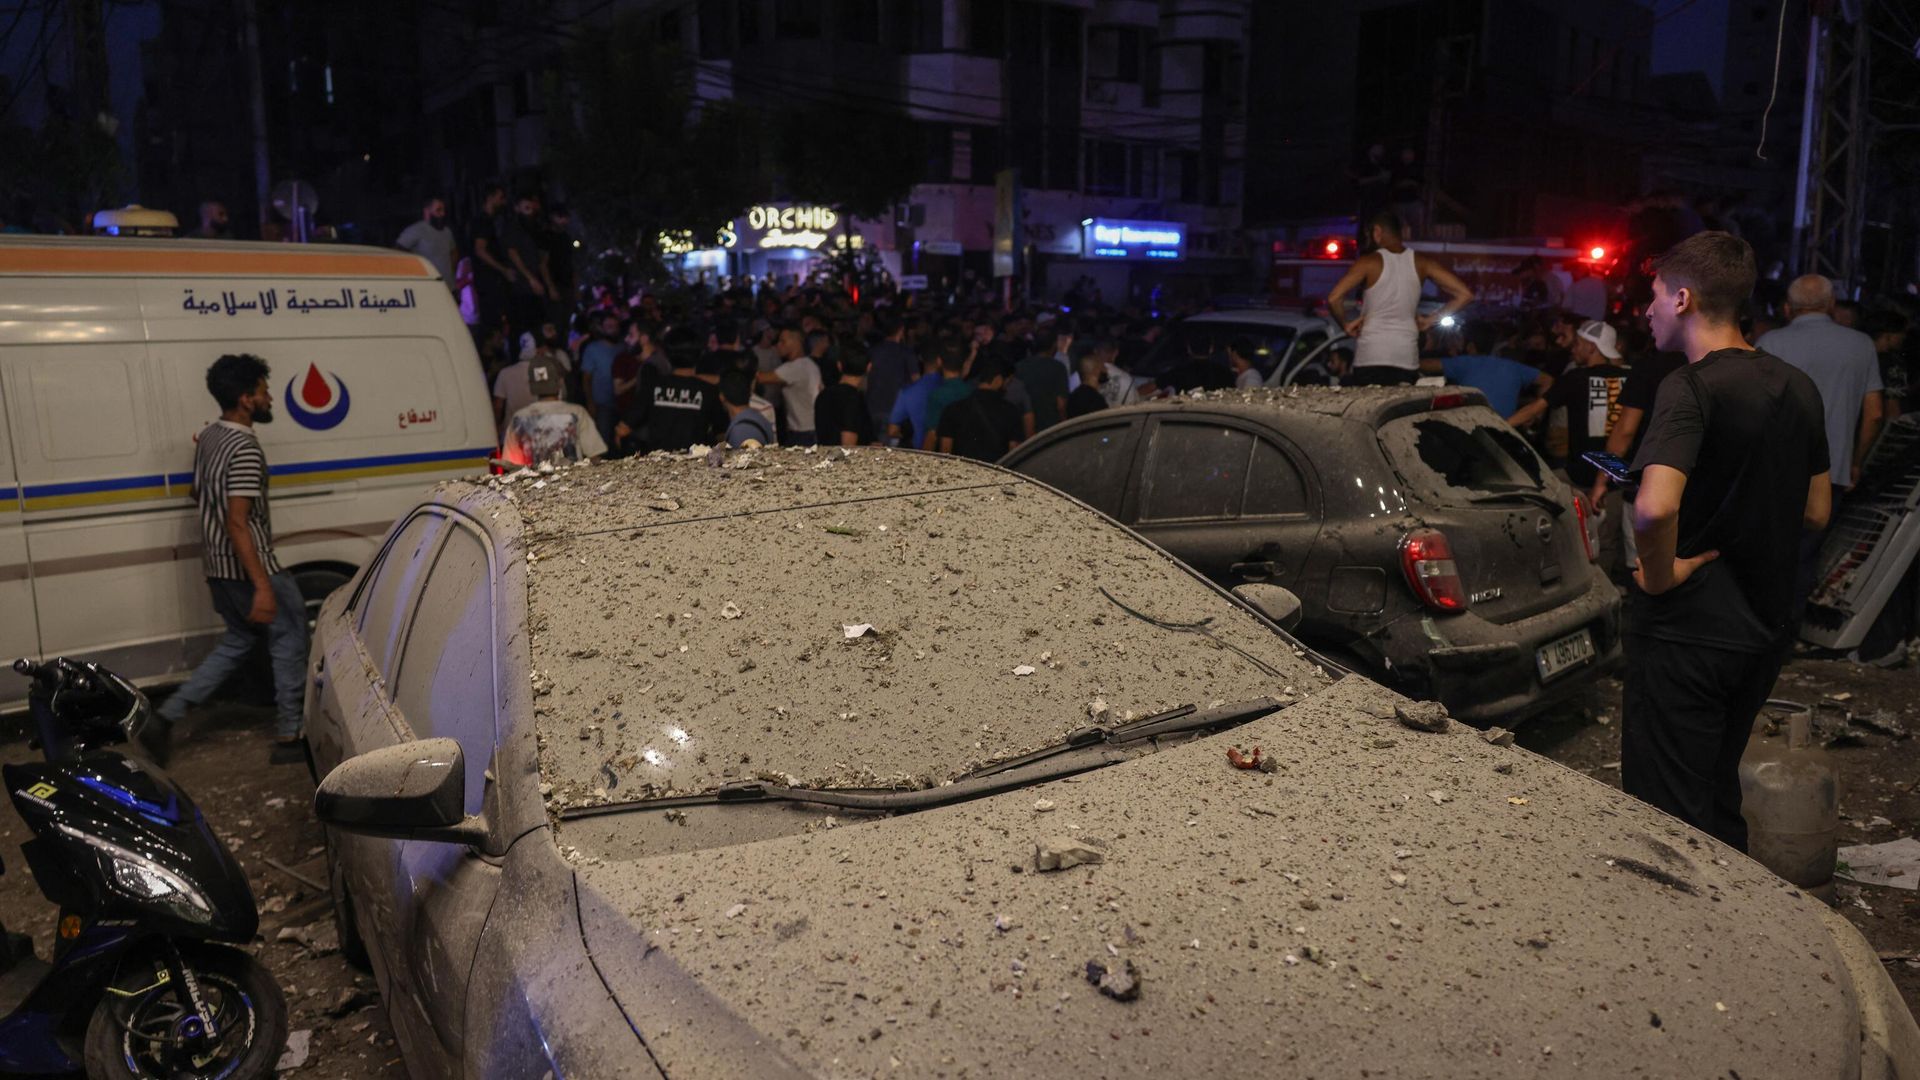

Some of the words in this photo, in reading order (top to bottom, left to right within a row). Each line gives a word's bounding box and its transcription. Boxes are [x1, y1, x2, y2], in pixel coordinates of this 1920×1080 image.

[748, 206, 837, 230] ORCHID
[287, 288, 354, 314] الصحية
[1590, 379, 1607, 410] THE
[398, 408, 437, 429] الدفاع
